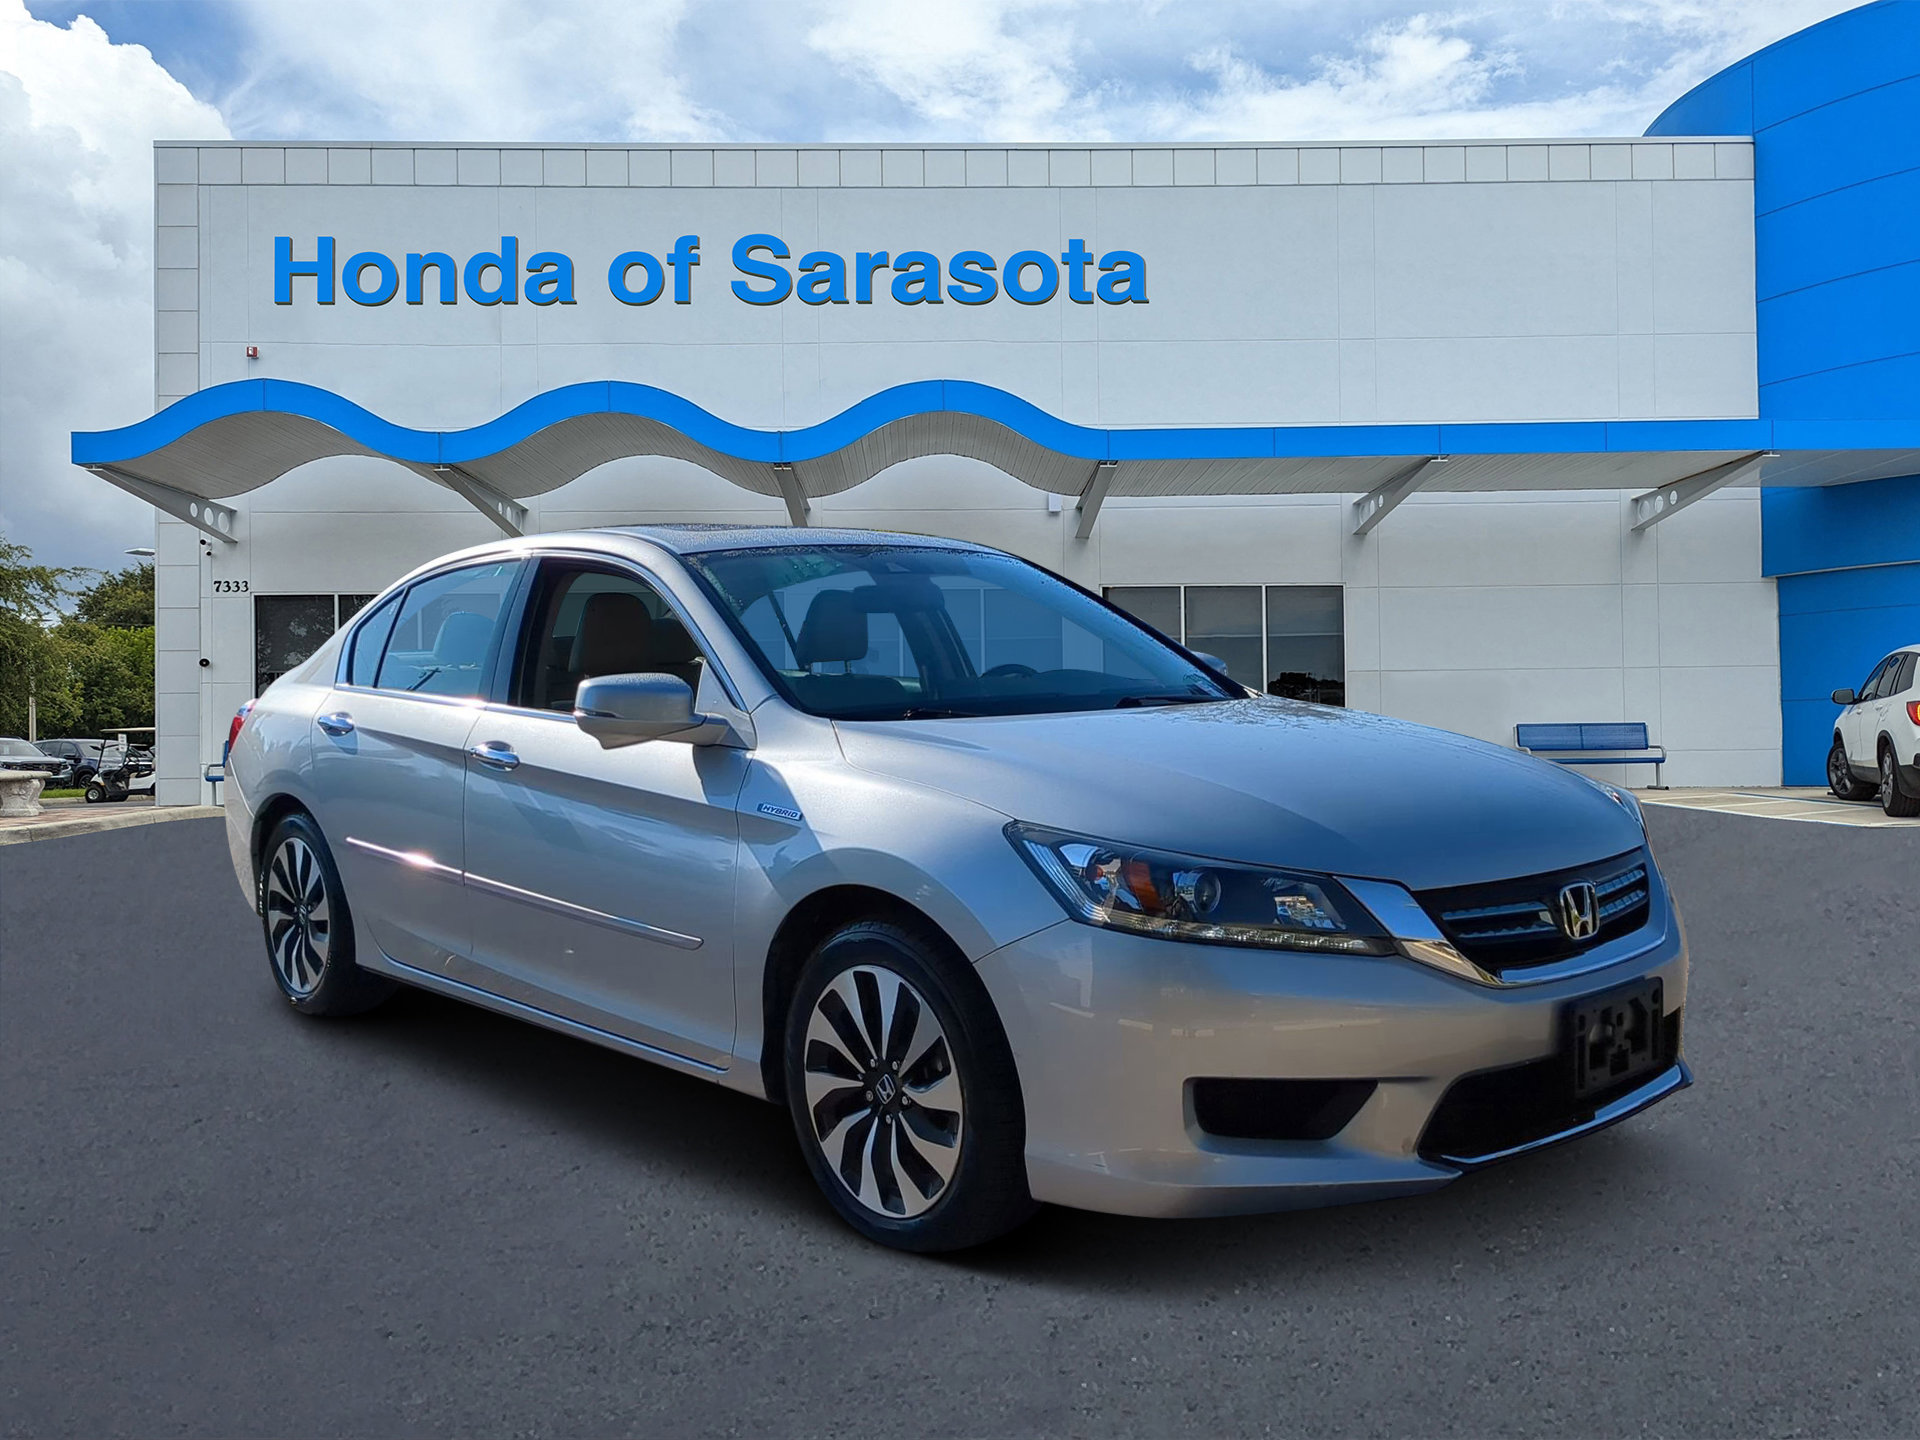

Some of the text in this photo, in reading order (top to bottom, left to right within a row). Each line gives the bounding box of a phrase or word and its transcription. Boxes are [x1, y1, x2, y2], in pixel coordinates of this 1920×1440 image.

[274, 233, 1150, 306] Honda of Sarasota
[213, 580, 249, 593] 7333
[762, 804, 799, 818] HYBRID
